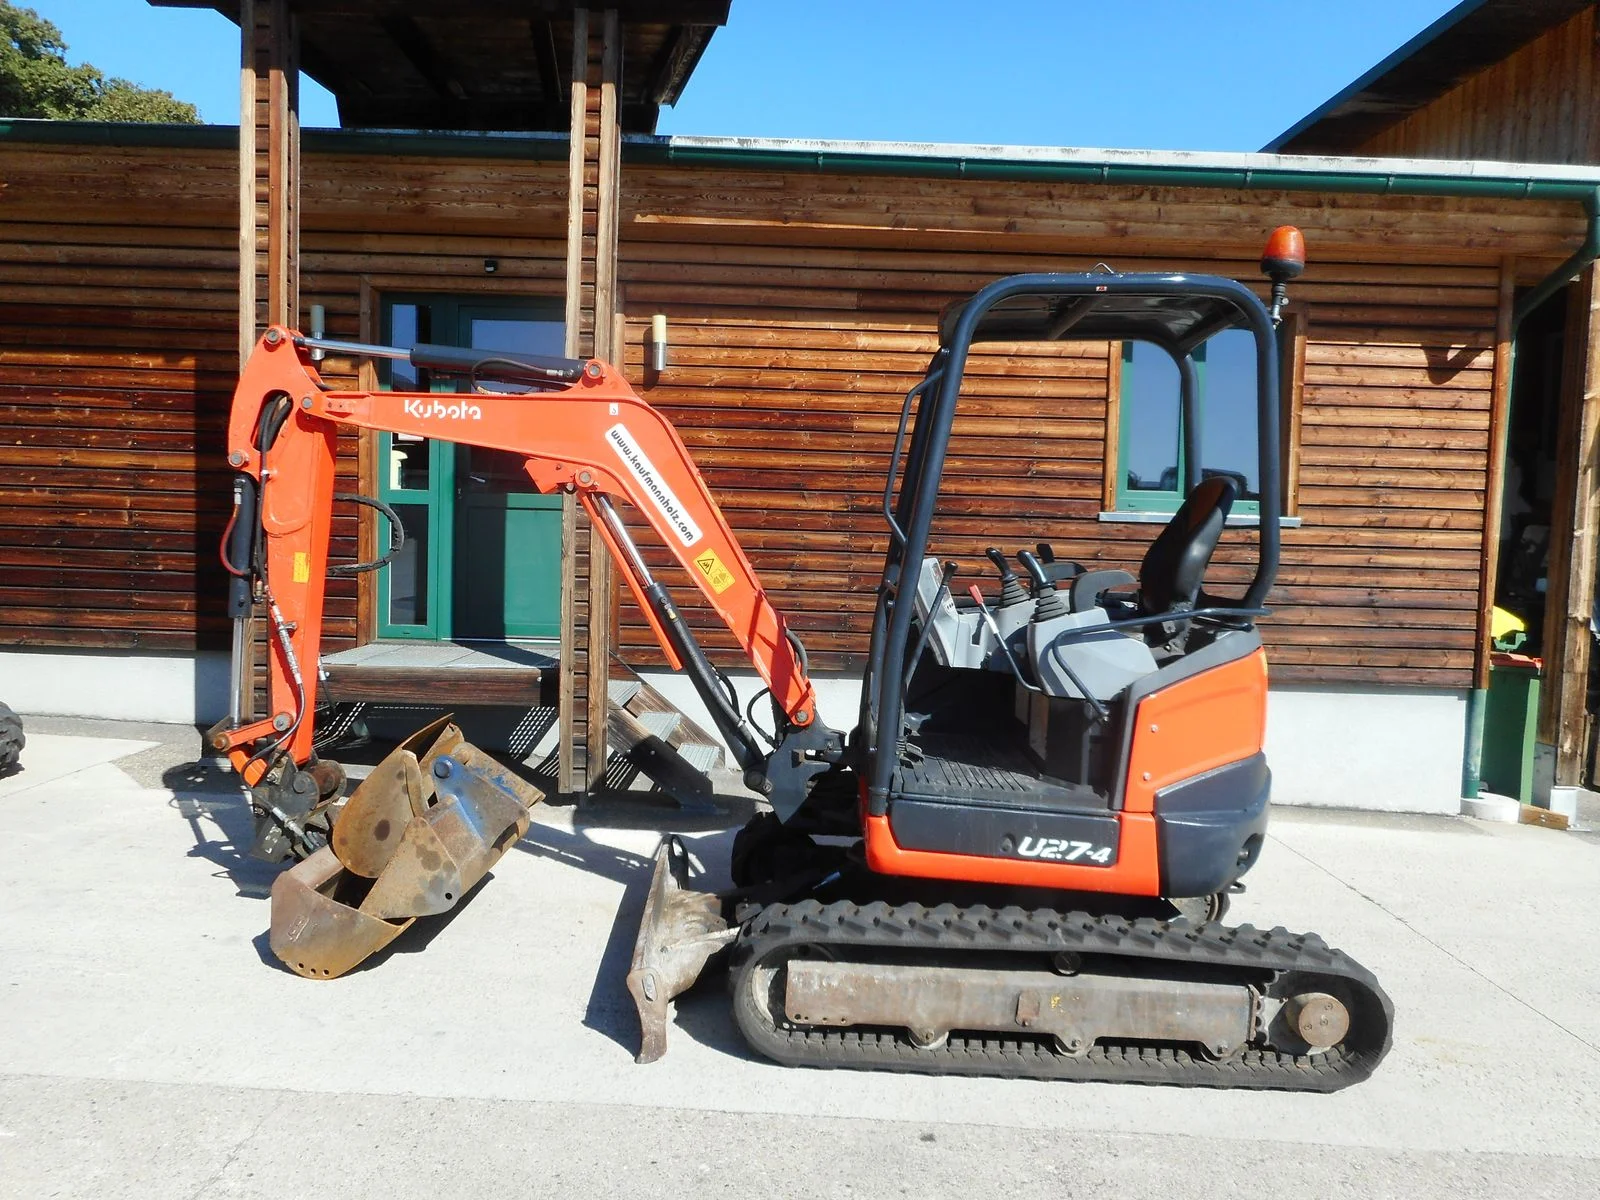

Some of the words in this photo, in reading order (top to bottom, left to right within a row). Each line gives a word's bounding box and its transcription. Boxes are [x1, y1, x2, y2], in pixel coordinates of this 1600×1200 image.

[404, 399, 481, 420] Kubota
[610, 430, 694, 541] www.kaufmannholz.com
[1017, 836, 1112, 863] U27-4
